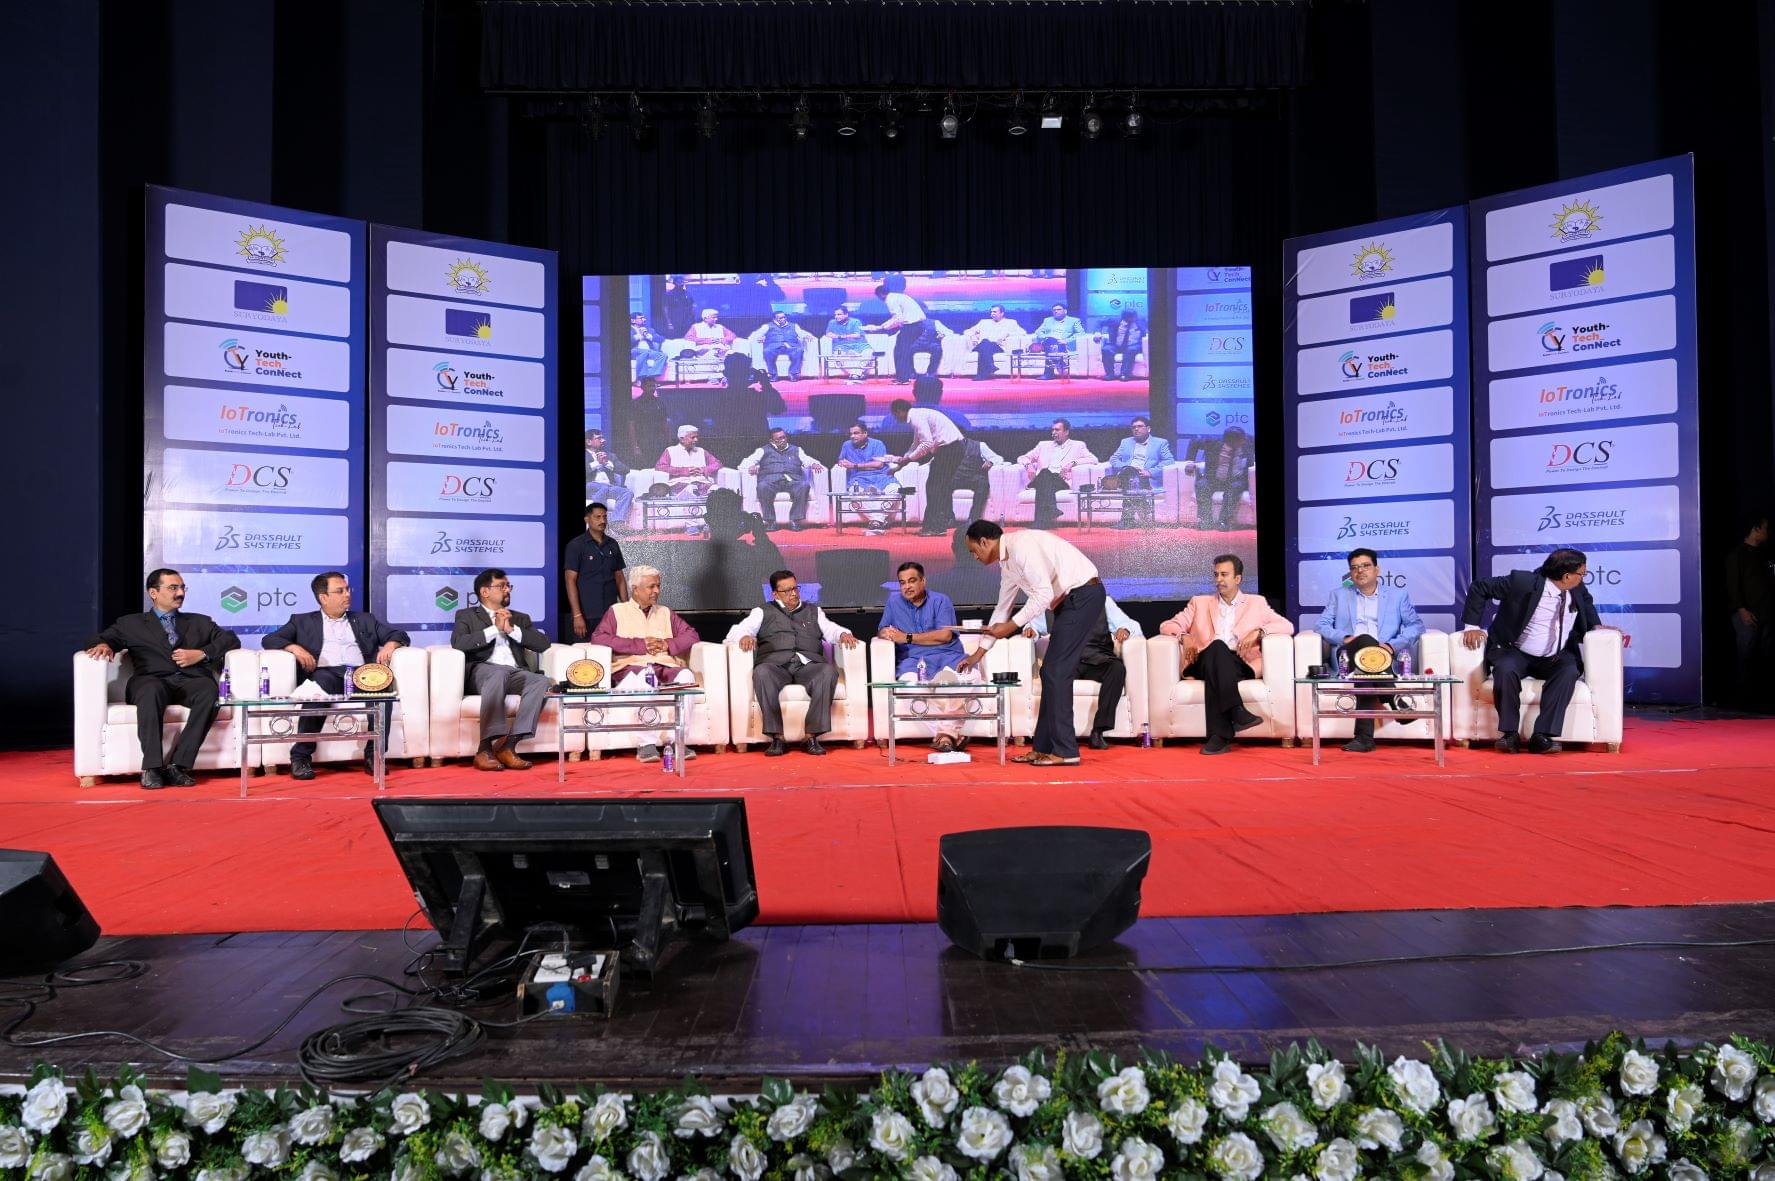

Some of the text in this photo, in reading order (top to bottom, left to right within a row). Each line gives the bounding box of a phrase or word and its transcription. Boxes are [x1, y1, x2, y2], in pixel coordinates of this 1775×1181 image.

[1572, 323, 1610, 334] Youth-
[1209, 336, 1245, 351] DCS
[1572, 339, 1622, 352] ConNect
[255, 349, 292, 360] Youth-
[1368, 353, 1399, 363] Youth-
[255, 367, 302, 379] ConNect
[463, 371, 495, 380] Youth-
[1368, 368, 1408, 379] ConNect
[463, 387, 504, 397] ConNect
[1540, 384, 1618, 403] IoTronics
[220, 405, 297, 424] IoTronics
[1225, 411, 1249, 426] ptc
[1340, 408, 1404, 425] IoTronics
[434, 422, 500, 439] IoTronics
[1546, 440, 1613, 467] DCS
[225, 463, 291, 488] DCS
[1345, 458, 1399, 481] DCS
[440, 475, 495, 497] DCS
[1566, 509, 1628, 519] DASSAULT
[1360, 520, 1410, 529] DASSAULT
[245, 534, 302, 542] DASSAULT
[257, 588, 297, 611] ptc
